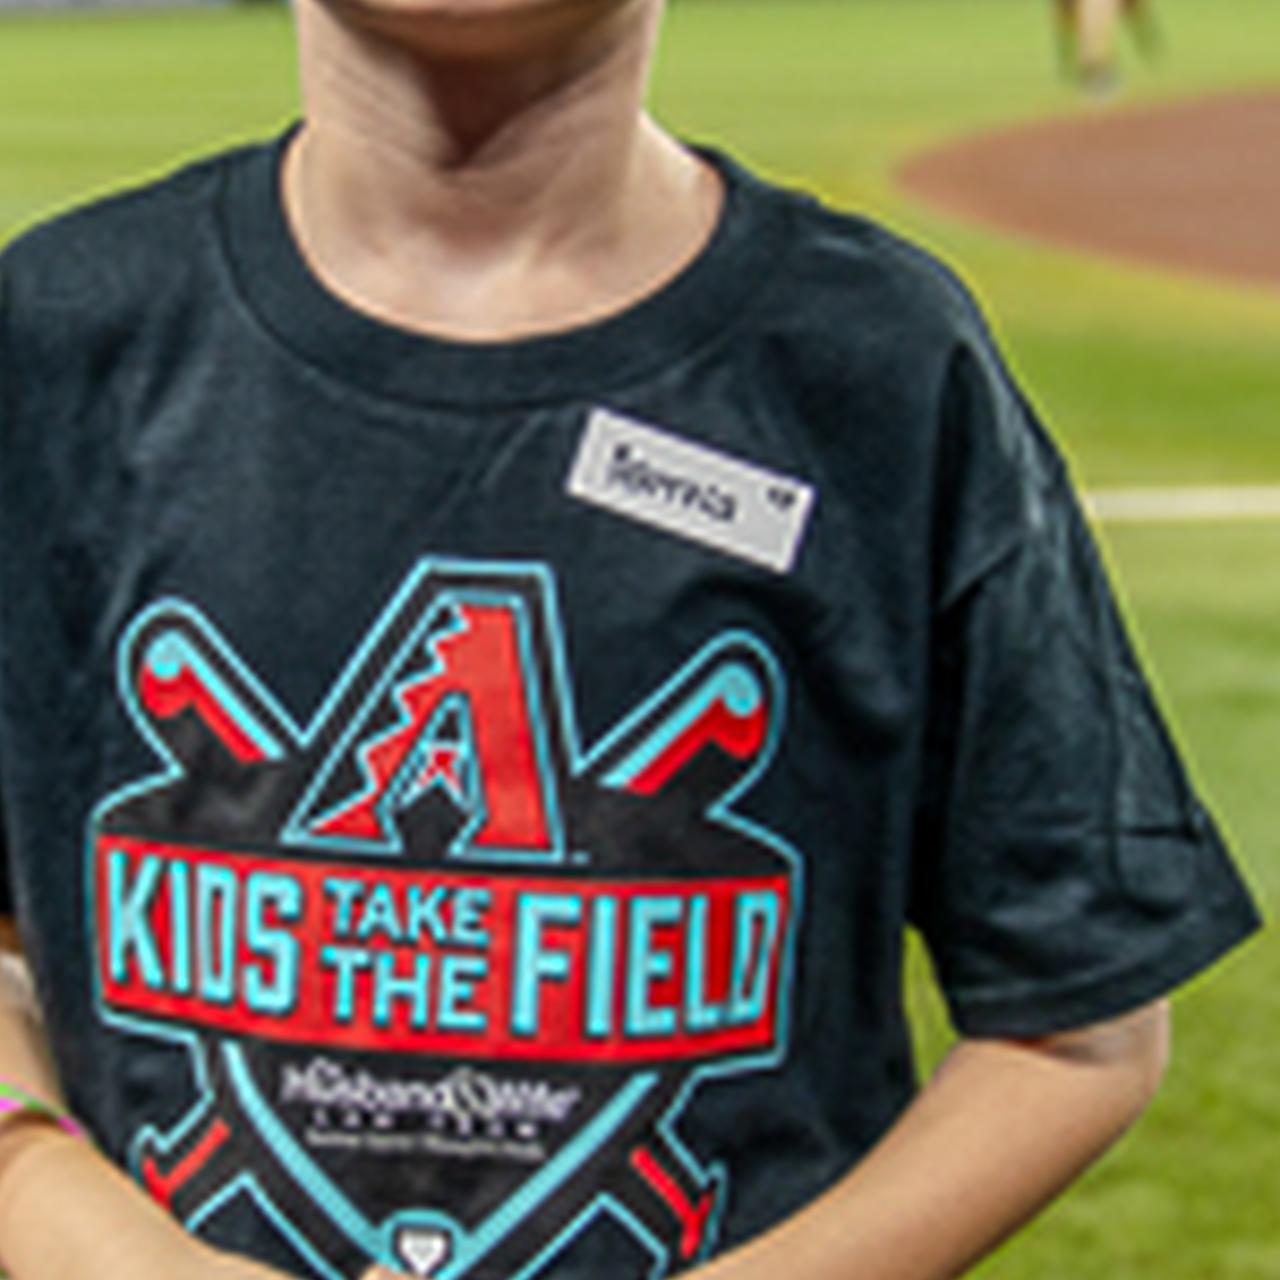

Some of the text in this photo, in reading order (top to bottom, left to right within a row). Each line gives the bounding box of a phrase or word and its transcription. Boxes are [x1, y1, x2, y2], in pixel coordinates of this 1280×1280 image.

[106, 848, 781, 1037] KIDS TAKE THE FIELD
